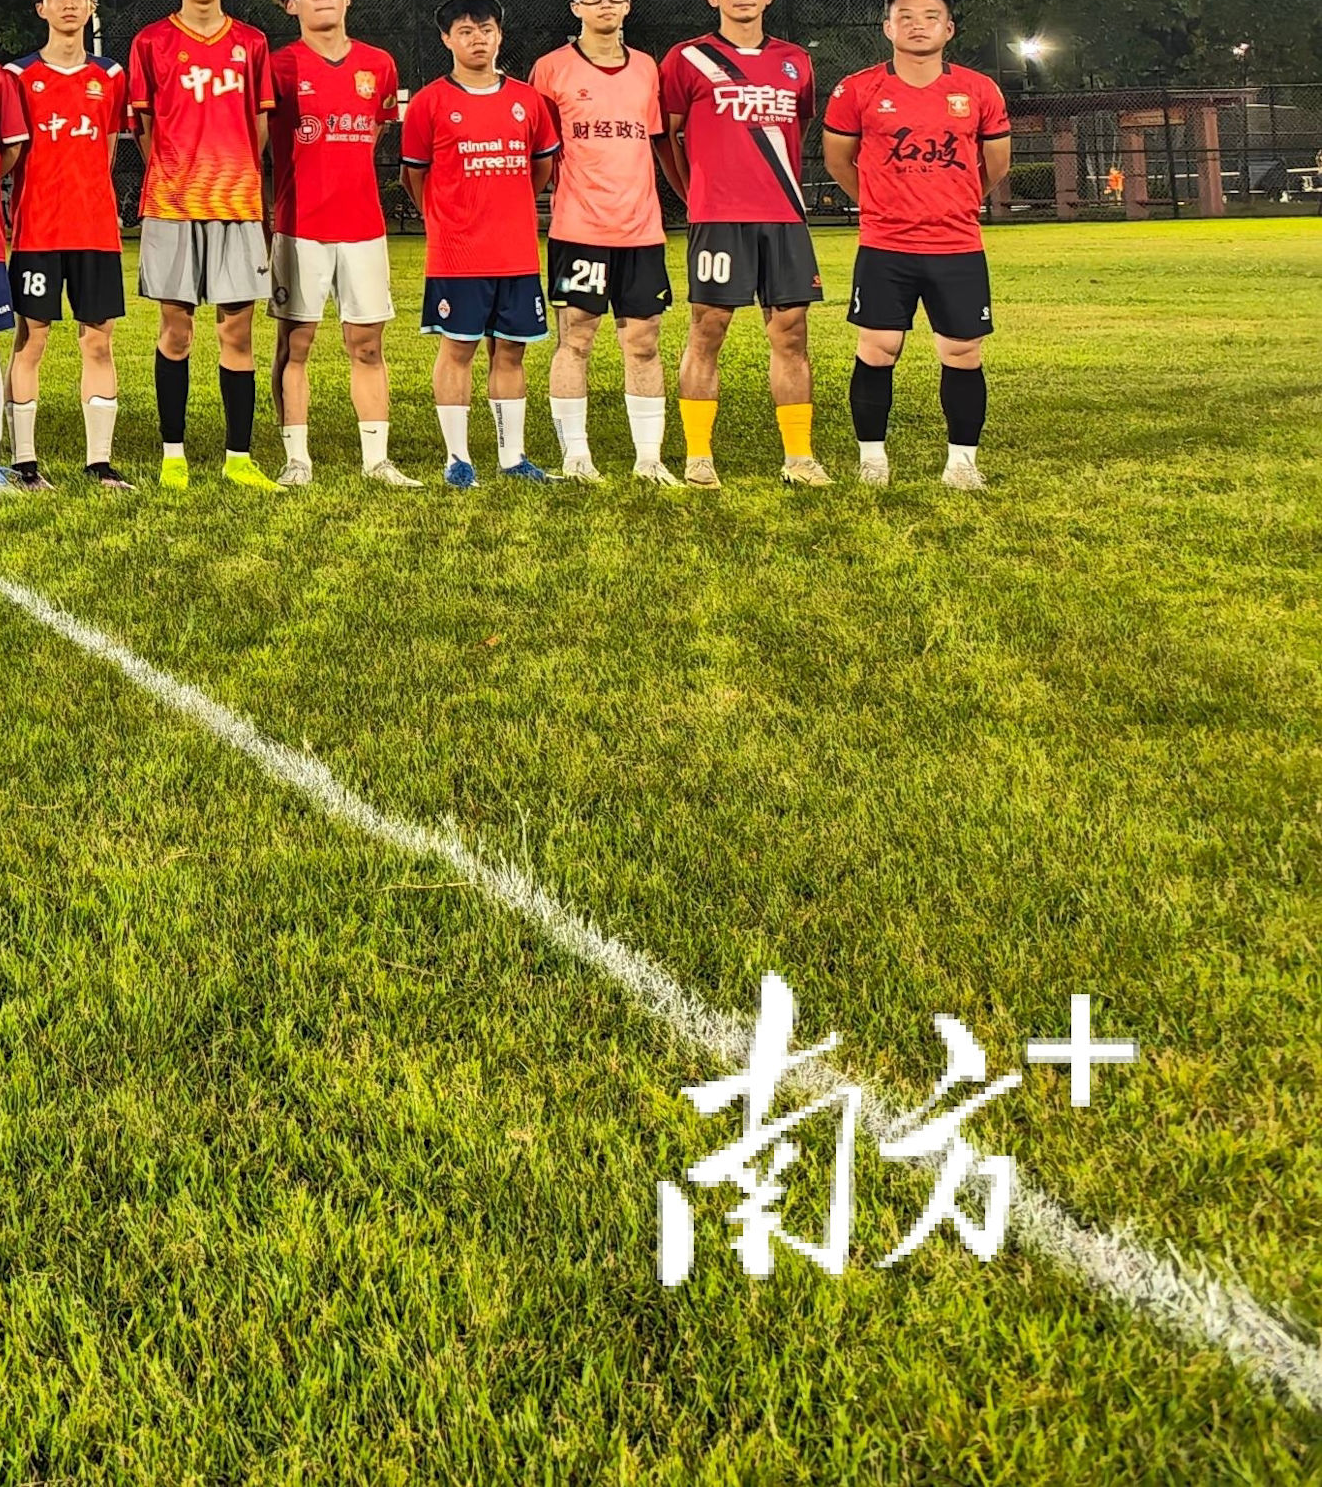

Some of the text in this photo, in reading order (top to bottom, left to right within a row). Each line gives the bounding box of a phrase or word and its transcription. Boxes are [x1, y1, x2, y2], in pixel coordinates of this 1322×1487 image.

[180, 65, 245, 103] 中山
[713, 84, 797, 121] 兄弟连
[37, 112, 98, 141] 中山
[572, 120, 647, 140] 财经政法
[458, 138, 503, 154] Rinnai
[570, 259, 607, 296] 24
[696, 250, 731, 284] 00
[22, 270, 46, 297] 18
